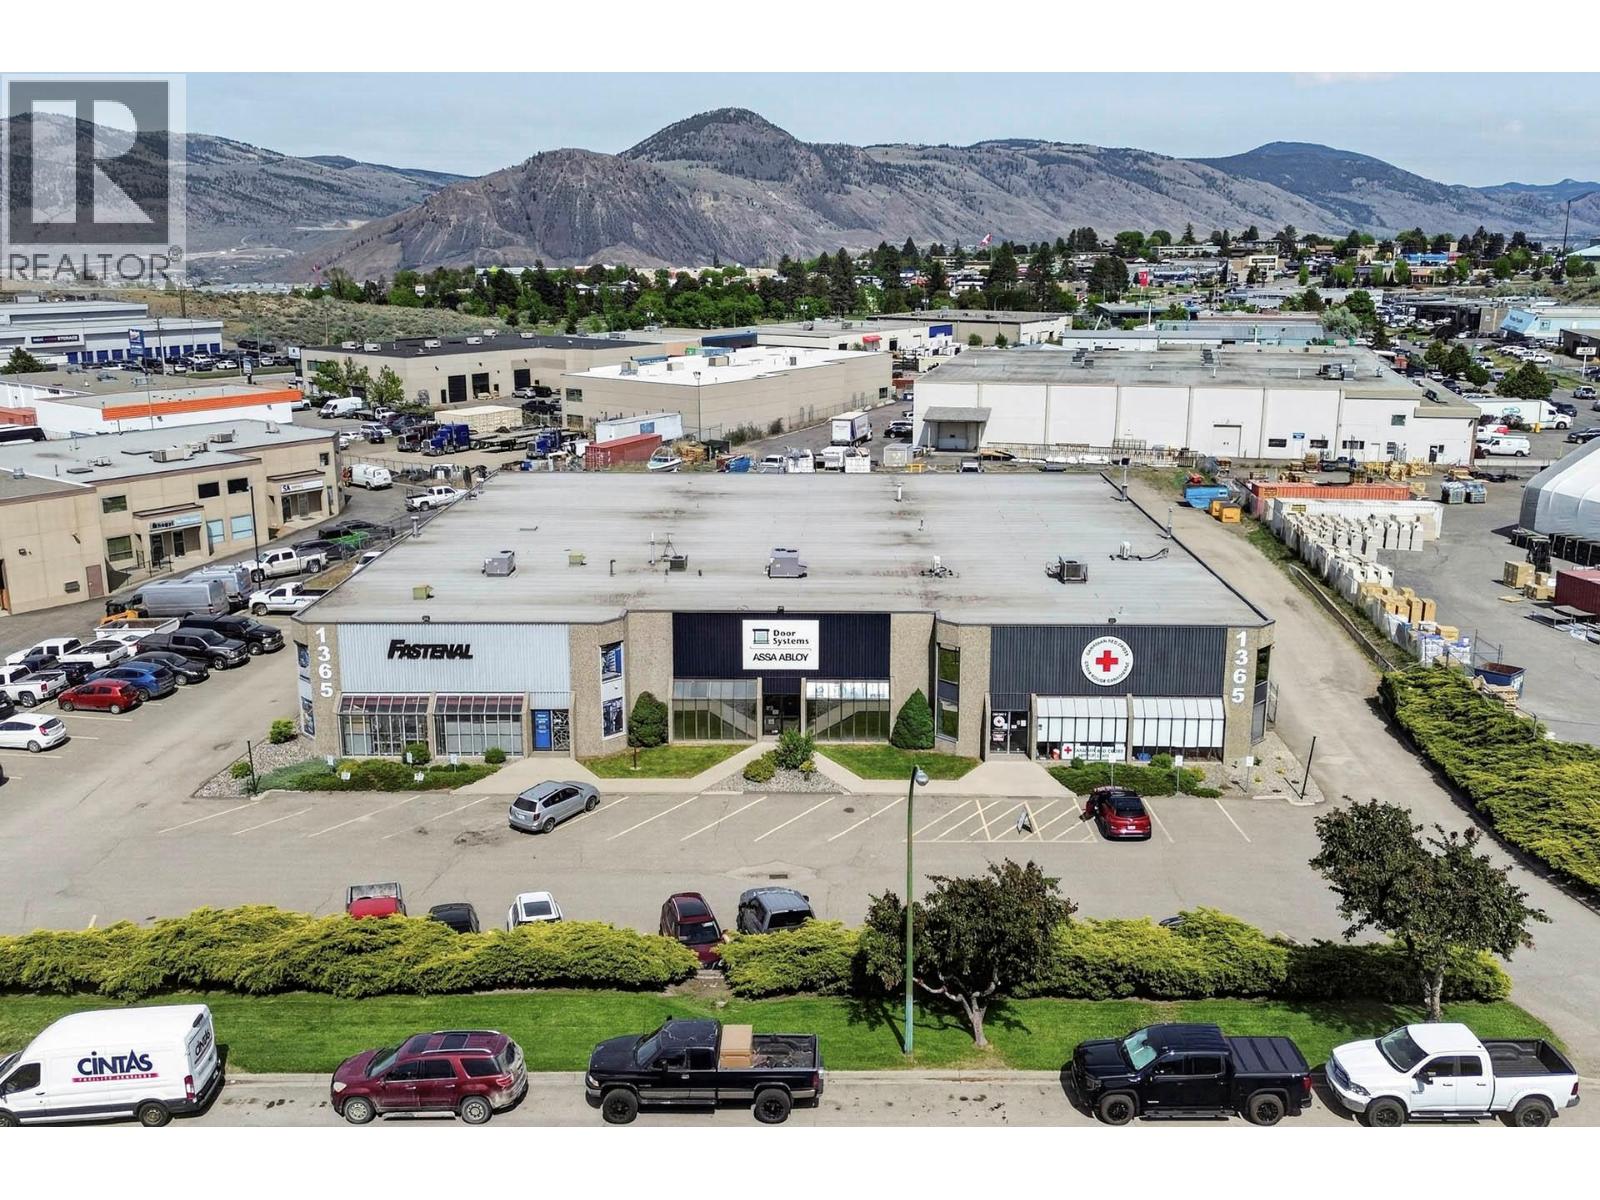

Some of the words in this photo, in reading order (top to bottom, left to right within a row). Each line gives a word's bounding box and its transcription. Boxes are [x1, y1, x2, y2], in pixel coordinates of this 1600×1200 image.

[773, 629, 796, 637] Door
[773, 637, 809, 646] Systems
[387, 639, 473, 660] FASTENAL
[753, 653, 777, 661] ASSA
[779, 653, 809, 661] ABLOY
[314, 626, 334, 699] 1365
[1231, 630, 1249, 704] 1365
